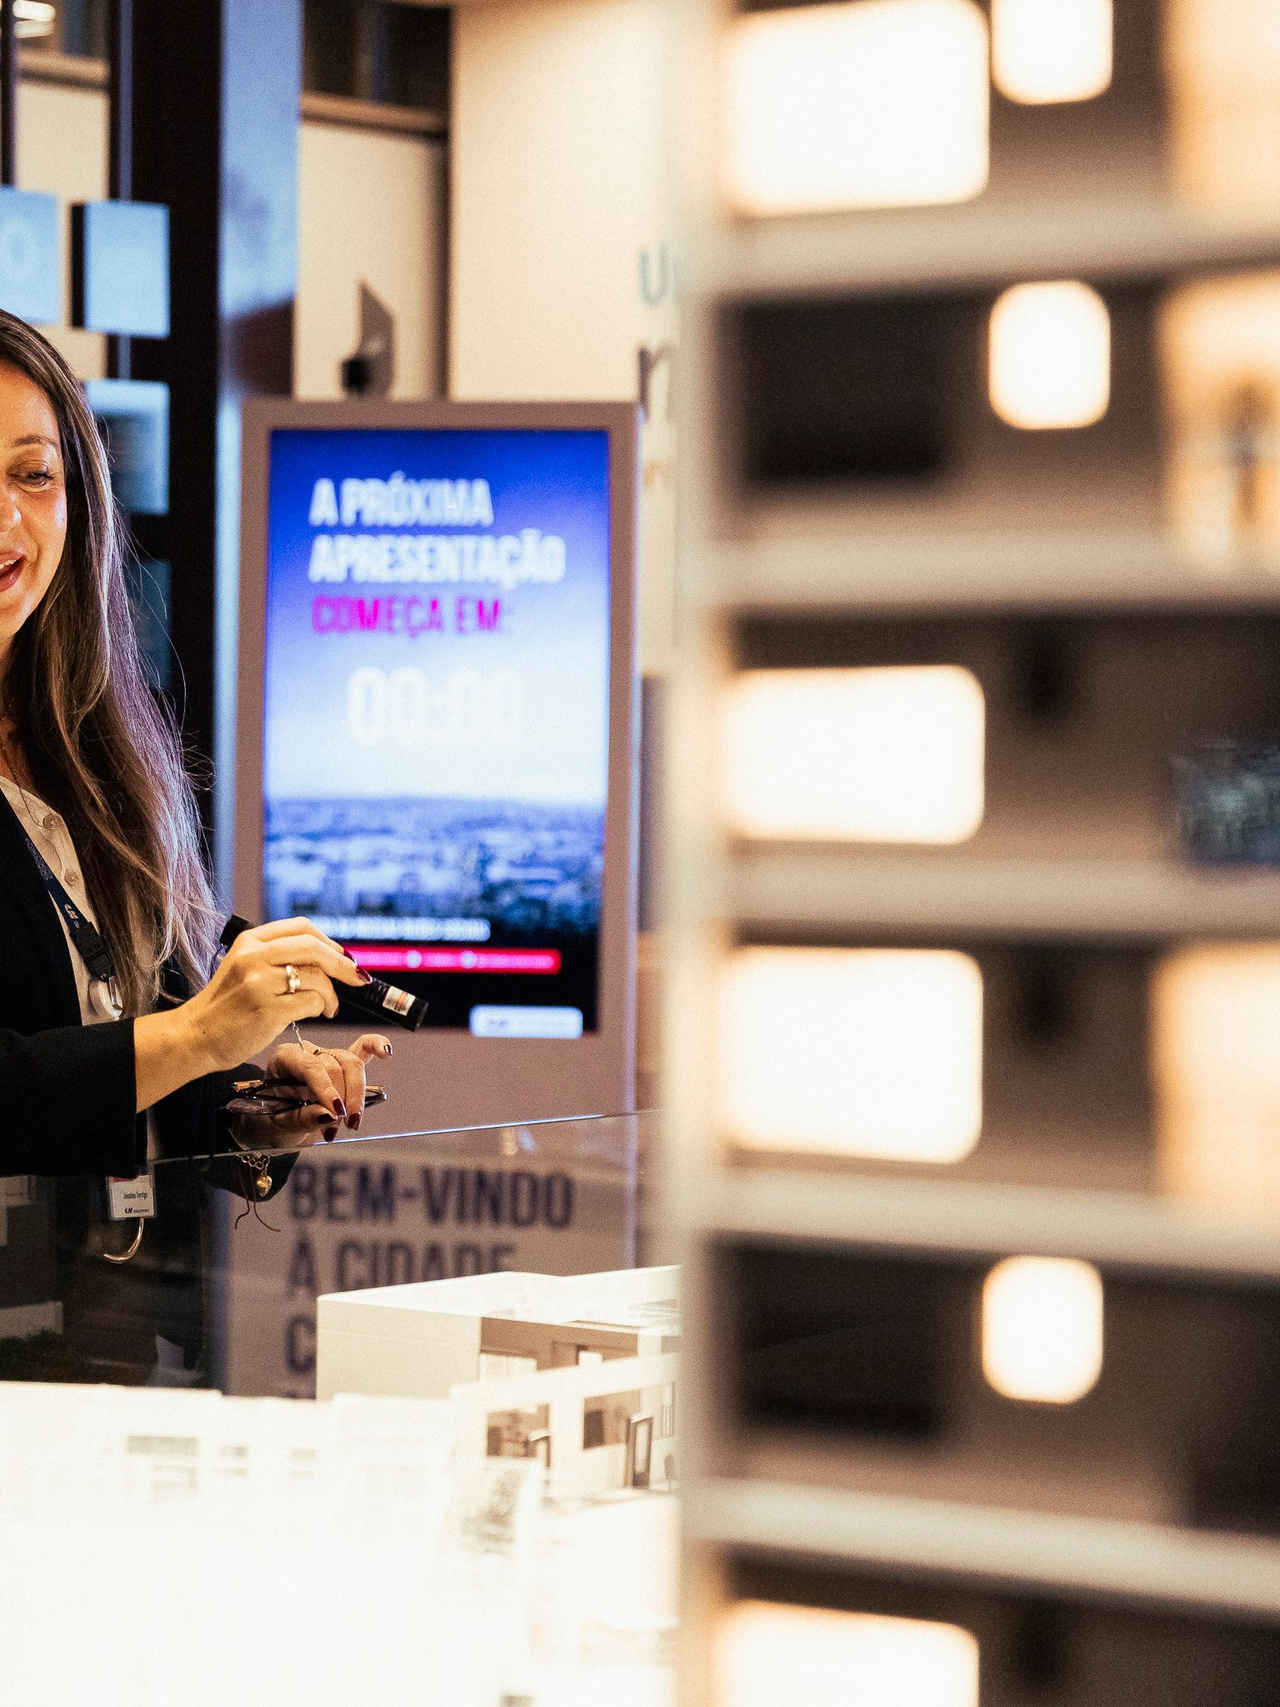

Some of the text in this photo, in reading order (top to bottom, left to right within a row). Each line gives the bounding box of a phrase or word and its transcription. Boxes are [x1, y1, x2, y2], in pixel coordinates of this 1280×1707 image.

[309, 470, 495, 527] A PRÓXIMA
[308, 528, 567, 591] APRESENTAÇÃO
[312, 596, 444, 640] COMEÇA
[289, 1161, 574, 1231] BEM-VINDO
